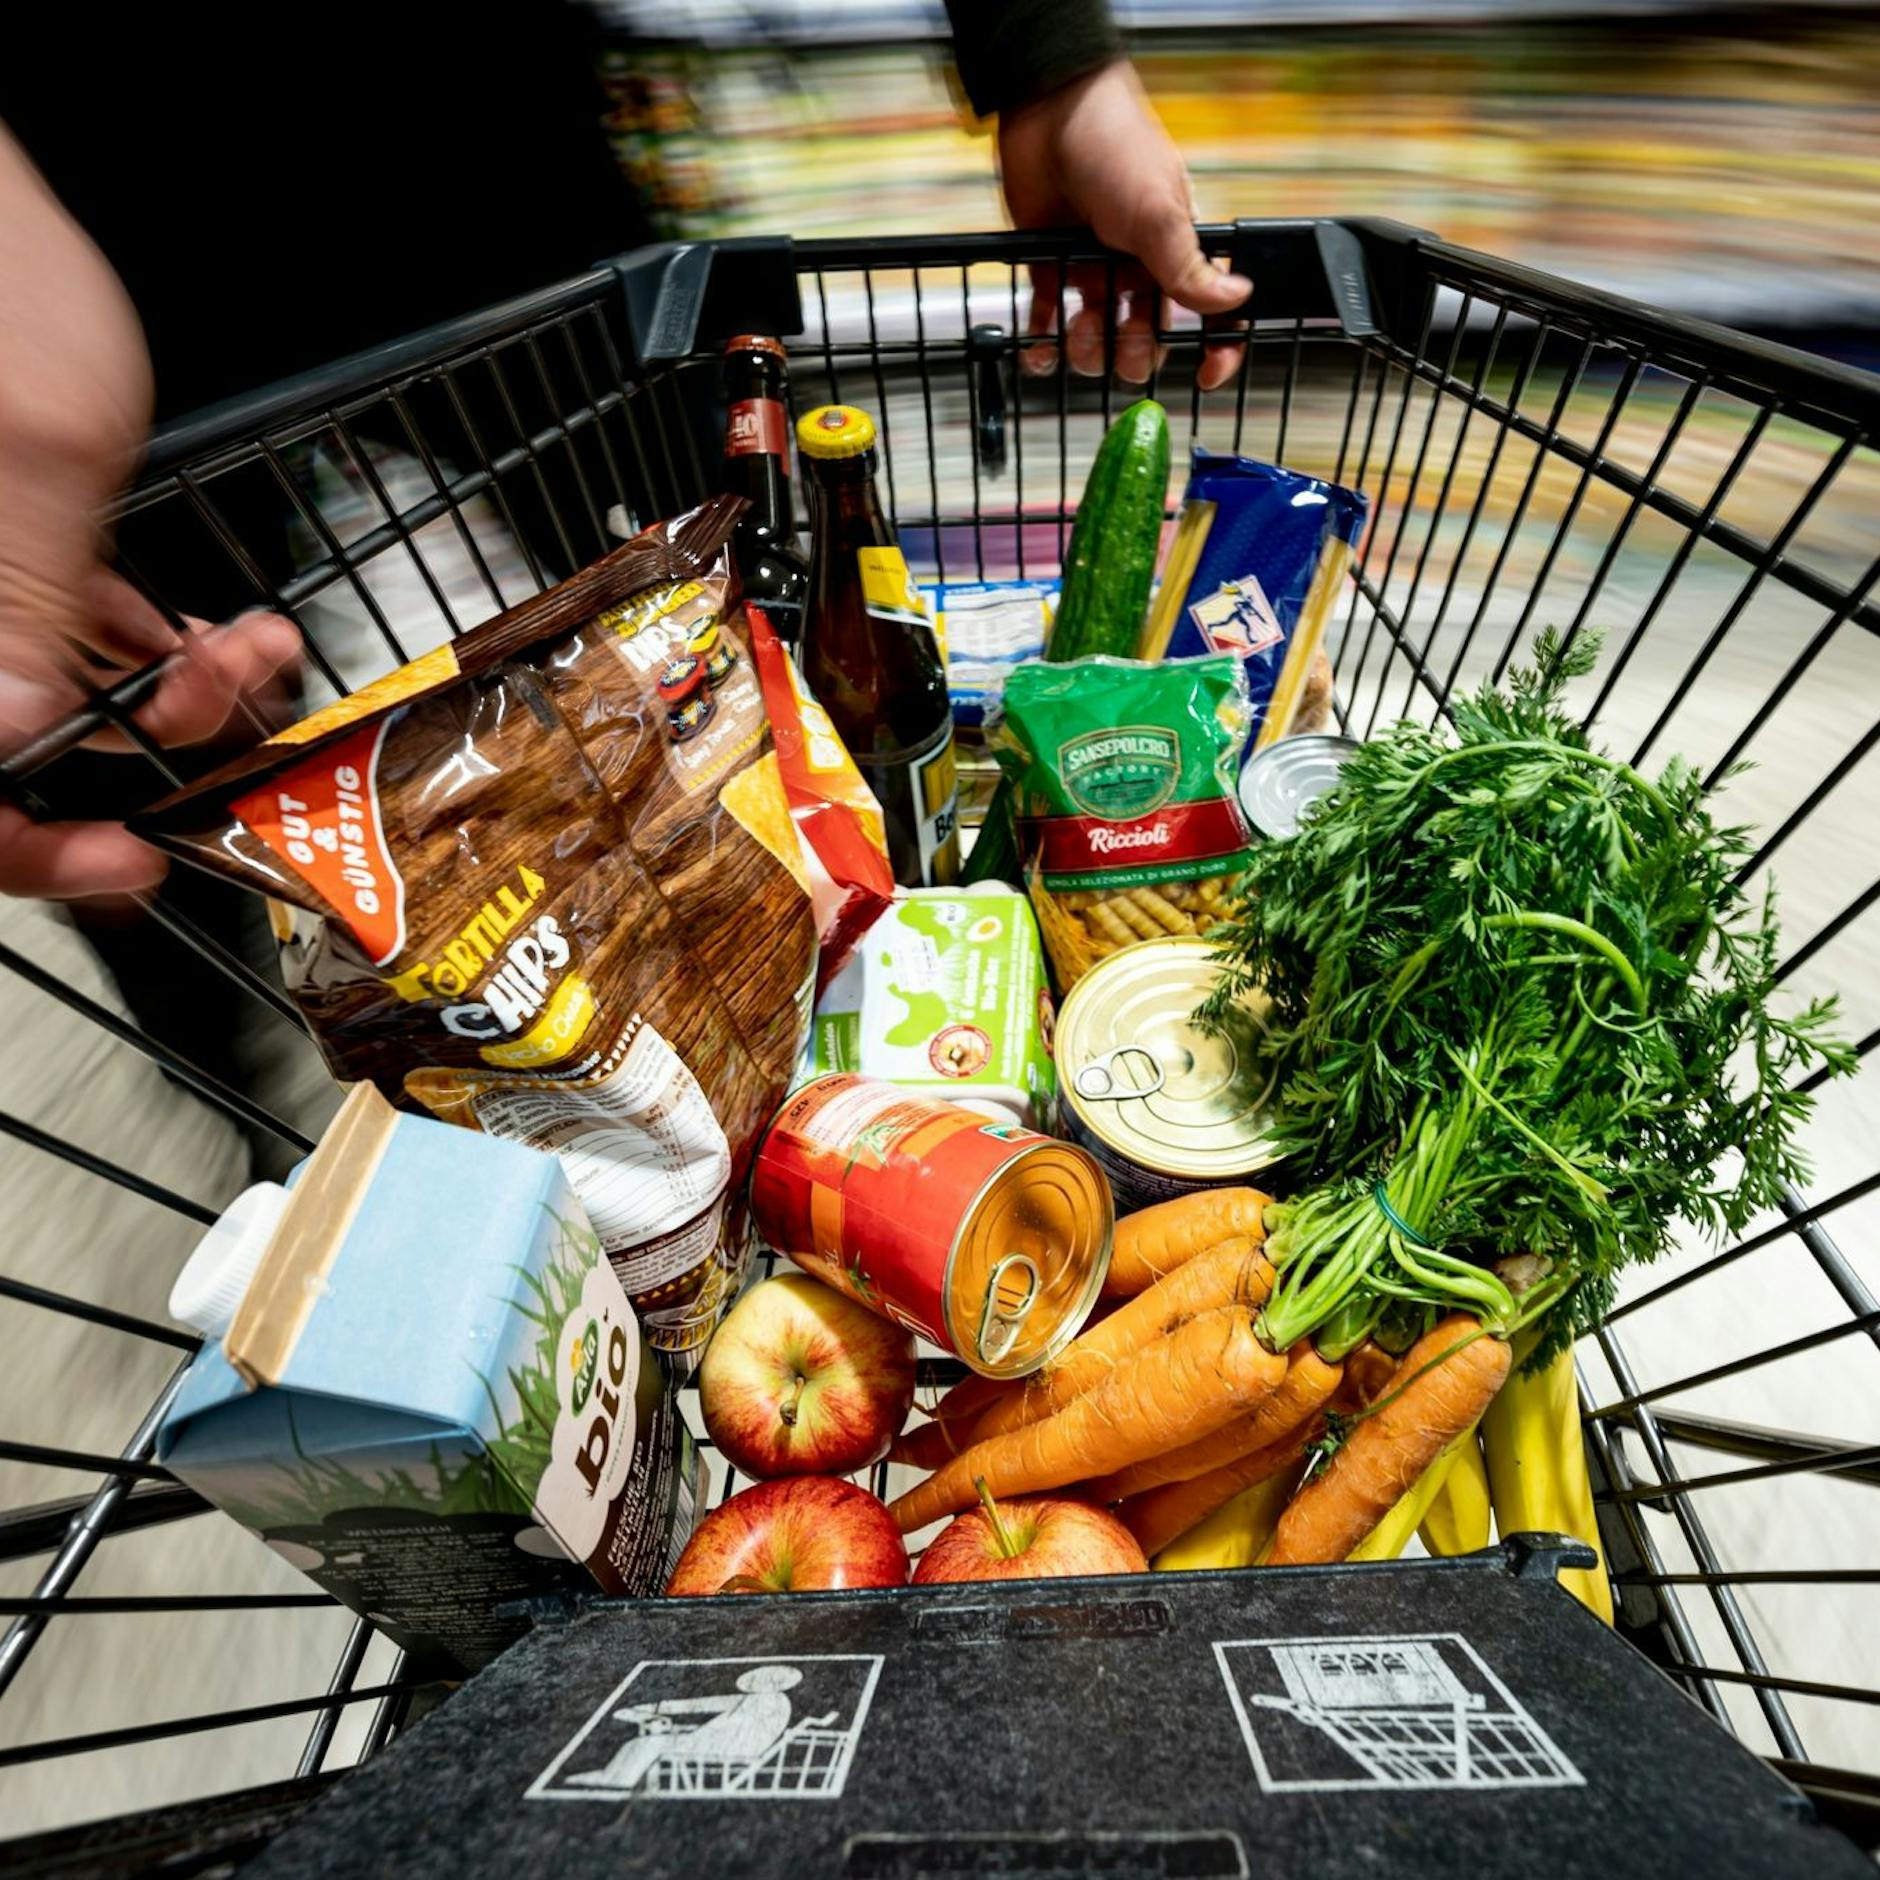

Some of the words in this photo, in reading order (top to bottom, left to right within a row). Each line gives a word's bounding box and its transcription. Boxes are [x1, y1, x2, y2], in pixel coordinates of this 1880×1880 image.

[1067, 736, 1171, 771] SANSEPOLCRO
[278, 792, 315, 864] GUT
[312, 827, 339, 853] &
[334, 765, 381, 915] GÜNSTIG
[1087, 821, 1170, 853] Riccioli
[1147, 871, 1158, 880] DI
[1161, 867, 1197, 878] GRANO
[1200, 862, 1228, 874] DURO
[383, 864, 546, 1003] TORTILLA
[440, 915, 570, 1039] CHIPS
[575, 1333, 598, 1404] Arla
[574, 1325, 628, 1500] bio
